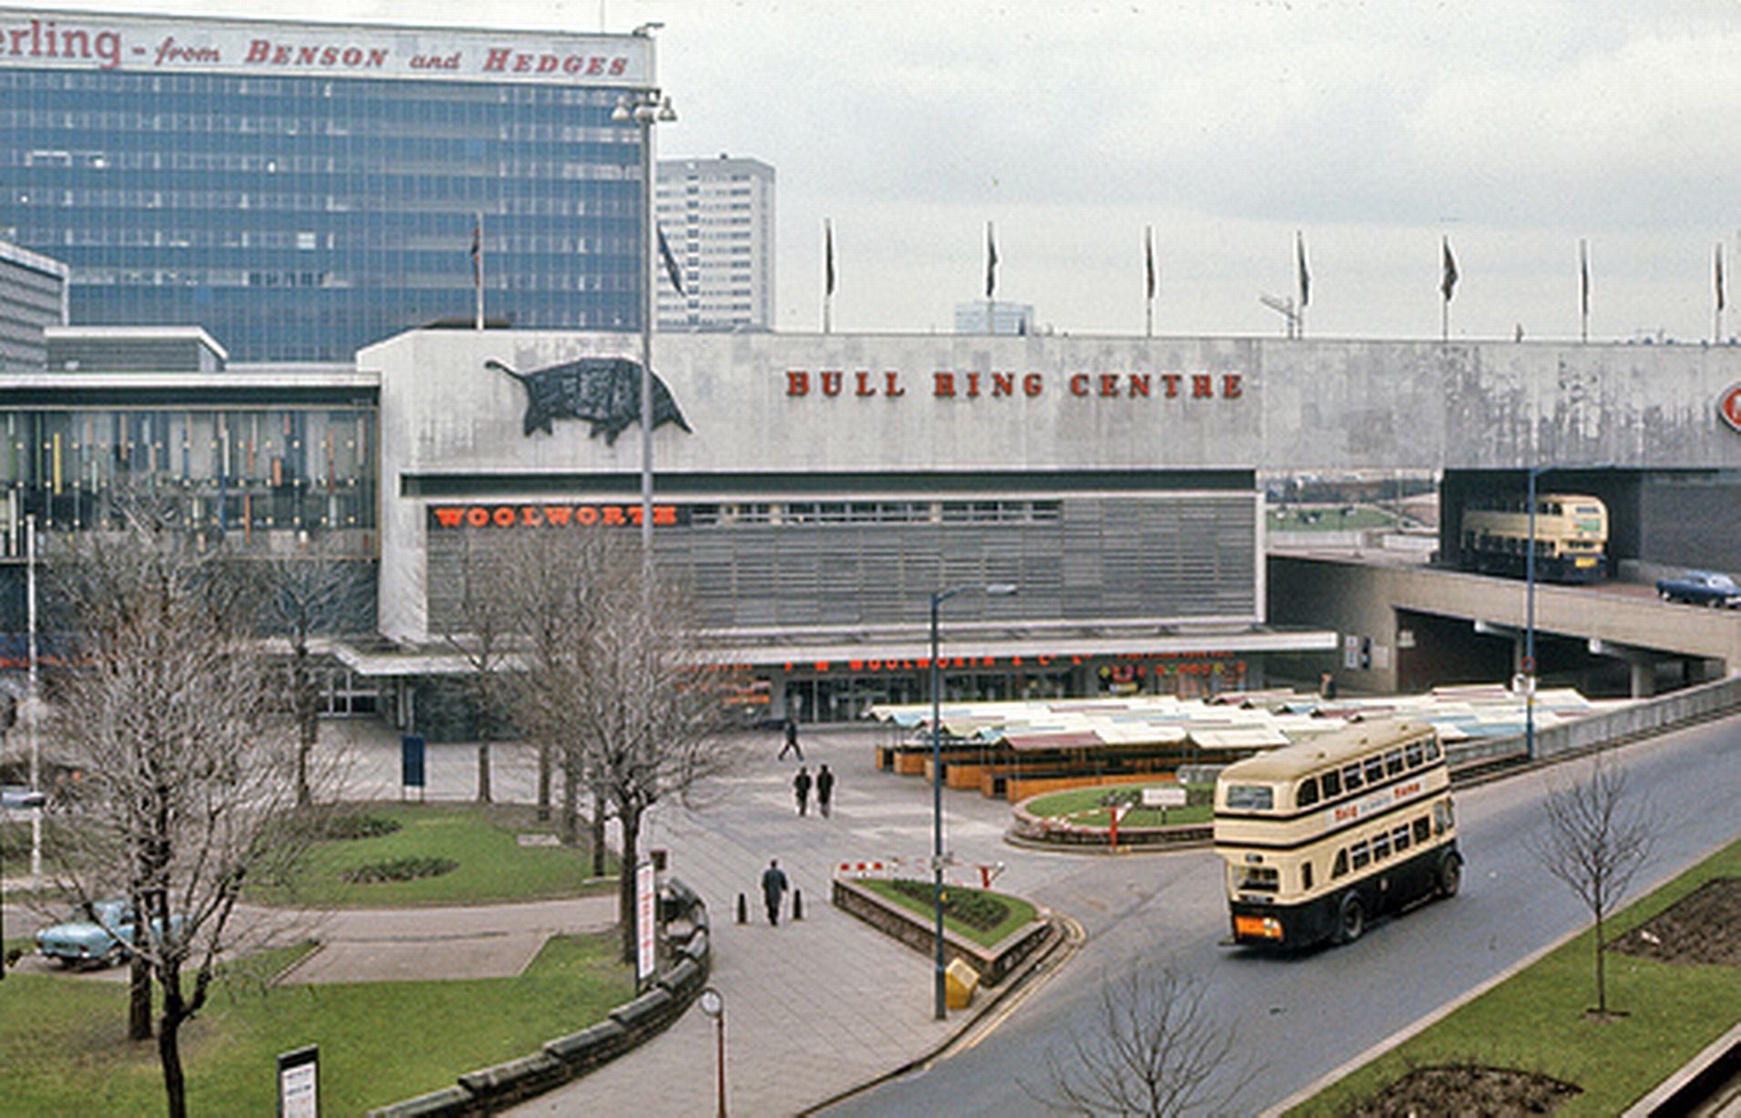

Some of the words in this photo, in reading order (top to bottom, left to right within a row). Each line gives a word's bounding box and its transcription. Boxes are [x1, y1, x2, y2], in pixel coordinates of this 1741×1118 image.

[0, 18, 121, 69] rling
[155, 37, 220, 66] from
[245, 39, 389, 67] BENSON
[409, 53, 461, 70] and
[483, 47, 628, 76] HEDGES
[786, 371, 905, 397] BULL
[932, 371, 1043, 397] RING
[1070, 373, 1243, 399] CENTRE
[434, 506, 677, 527] WOOLWORTH
